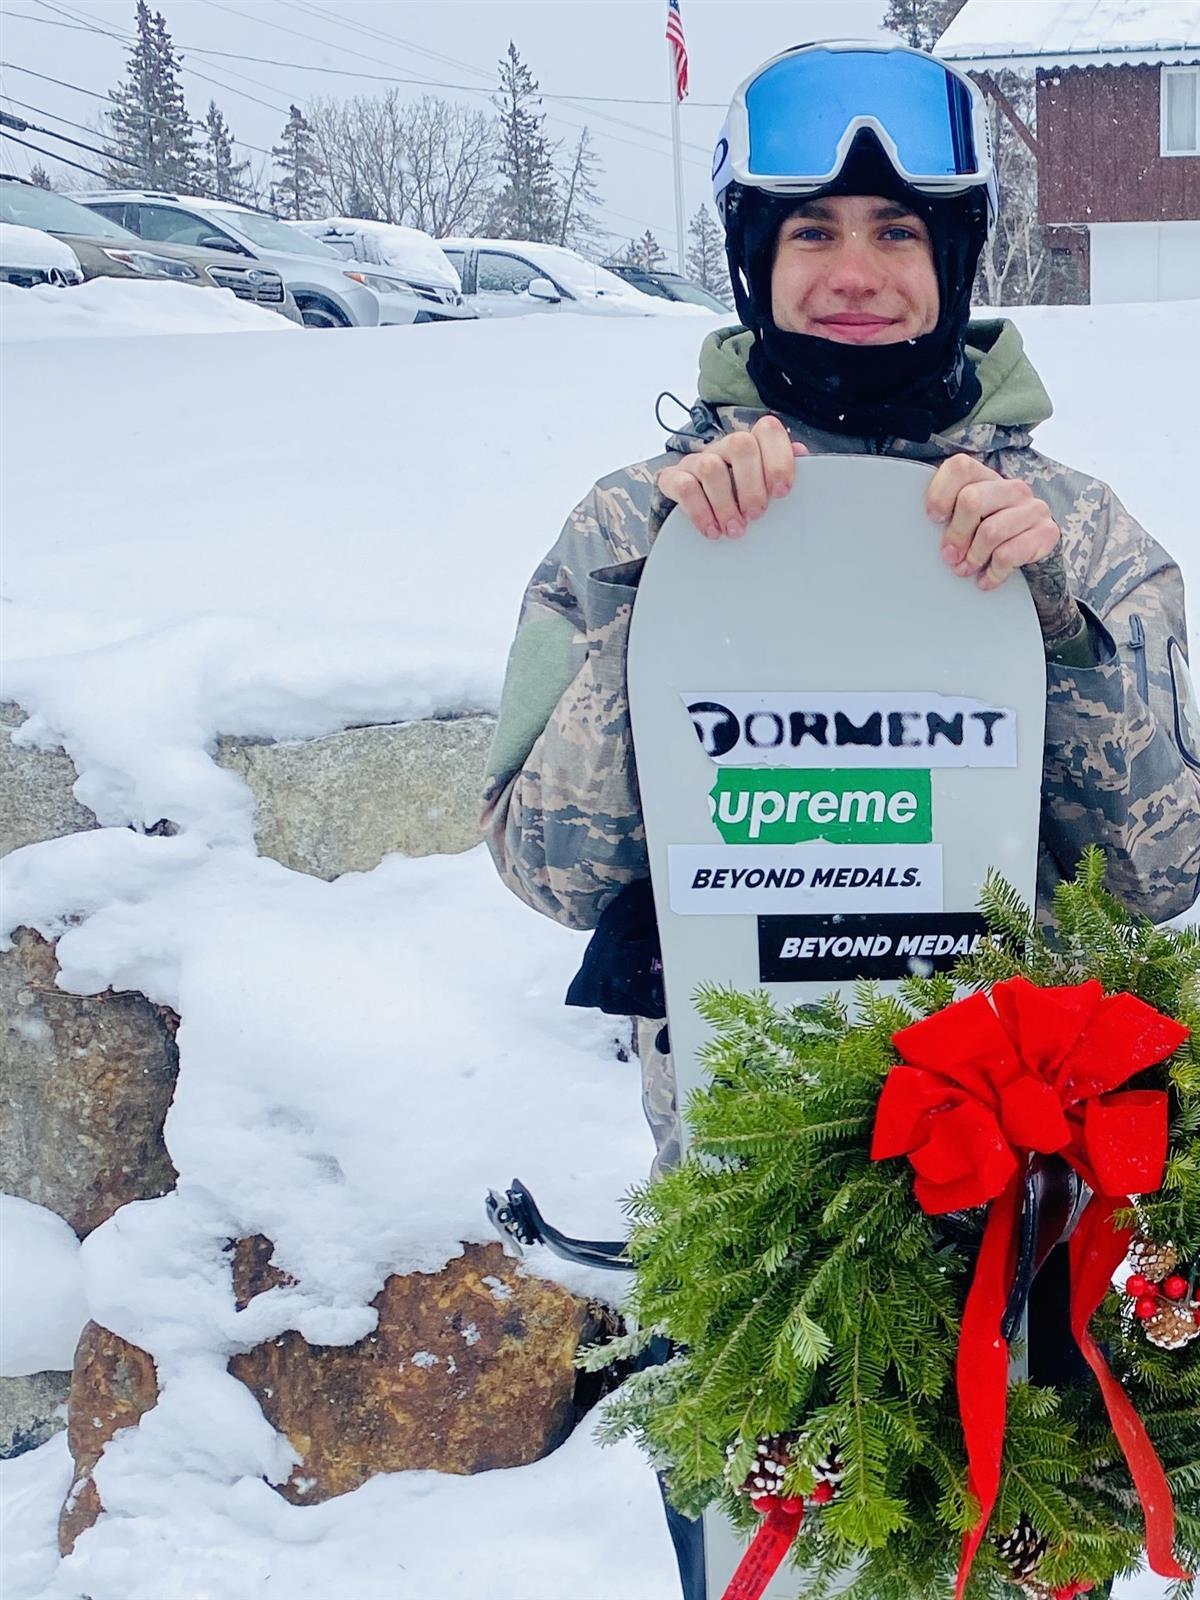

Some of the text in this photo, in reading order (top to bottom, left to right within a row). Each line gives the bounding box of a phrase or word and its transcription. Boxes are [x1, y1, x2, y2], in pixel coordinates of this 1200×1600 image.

[708, 789, 917, 838] upreme
[691, 867, 922, 889] BEYOND MEDALS.
[779, 935, 892, 958] BEYOND
